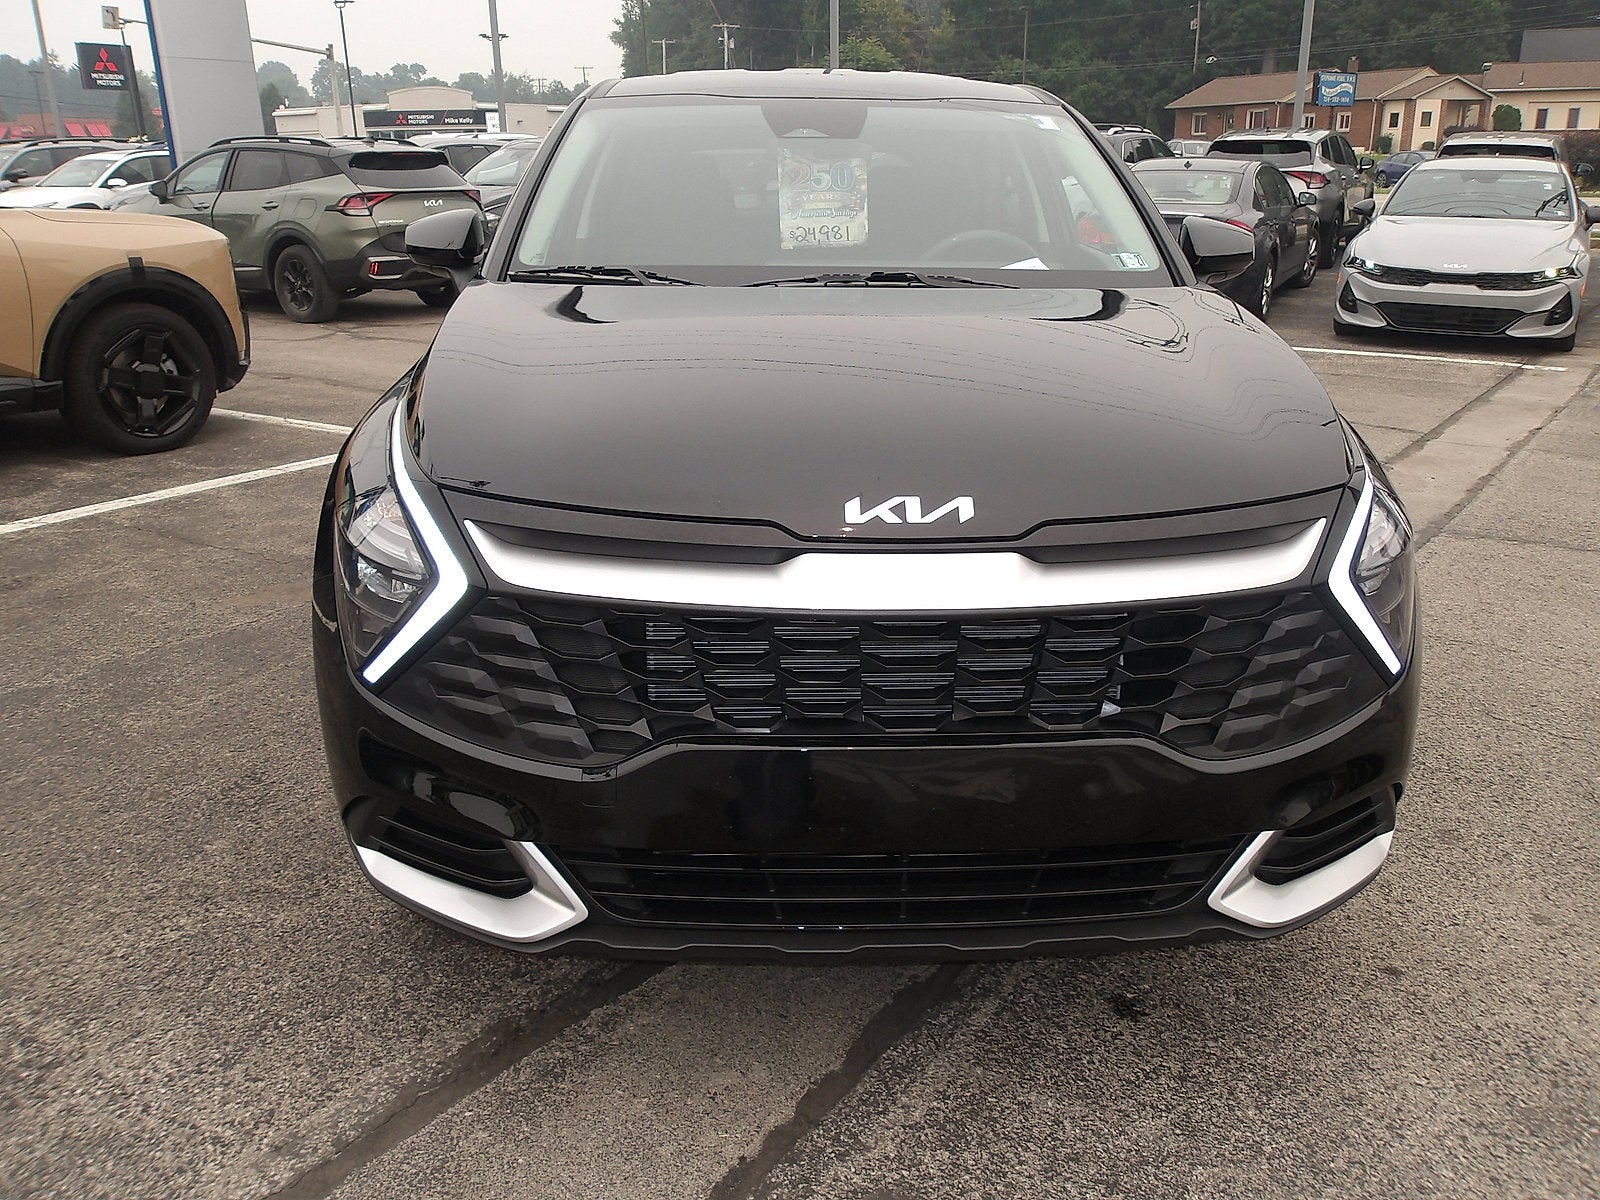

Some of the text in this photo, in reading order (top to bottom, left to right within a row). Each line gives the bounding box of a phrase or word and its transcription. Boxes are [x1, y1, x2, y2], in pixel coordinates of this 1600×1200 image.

[790, 160, 855, 192] 250
[792, 206, 859, 220] American Savings
[789, 224, 850, 246] $24,981
[844, 496, 975, 524] KIA
